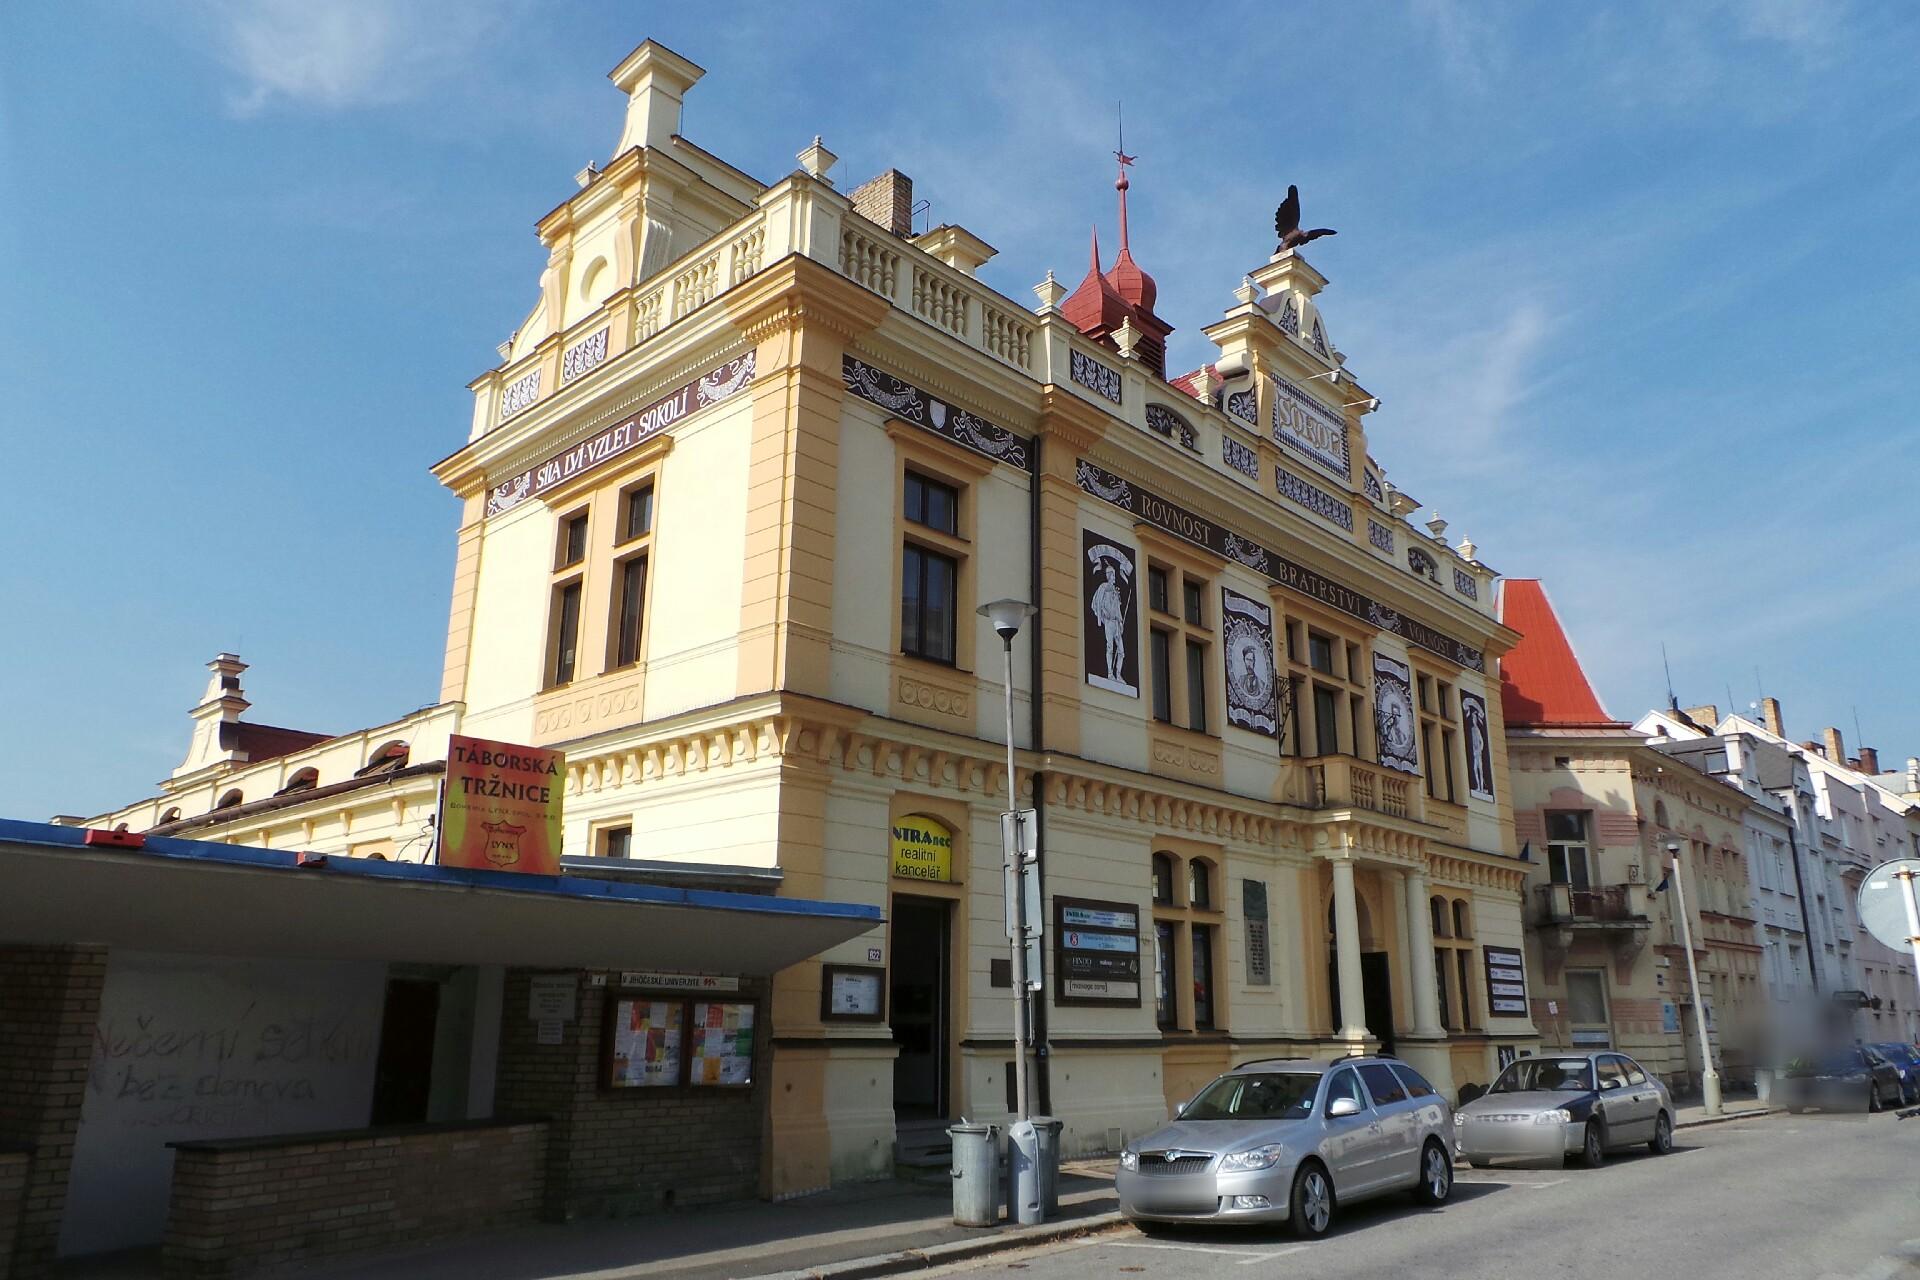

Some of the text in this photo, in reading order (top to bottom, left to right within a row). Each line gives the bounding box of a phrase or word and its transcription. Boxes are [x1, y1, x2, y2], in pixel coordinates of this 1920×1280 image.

[587, 421, 634, 463] VZLET
[638, 387, 689, 439] SOKOLÍ
[1278, 396, 1342, 459] SOKOL
[1141, 494, 1211, 545] ROVNOST
[1408, 622, 1450, 657] VOLNOST
[455, 743, 558, 776] TÁBORSKÁ
[461, 773, 550, 803] TRŽNICE
[896, 861, 941, 880] kancelář
[901, 848, 936, 862] realitní
